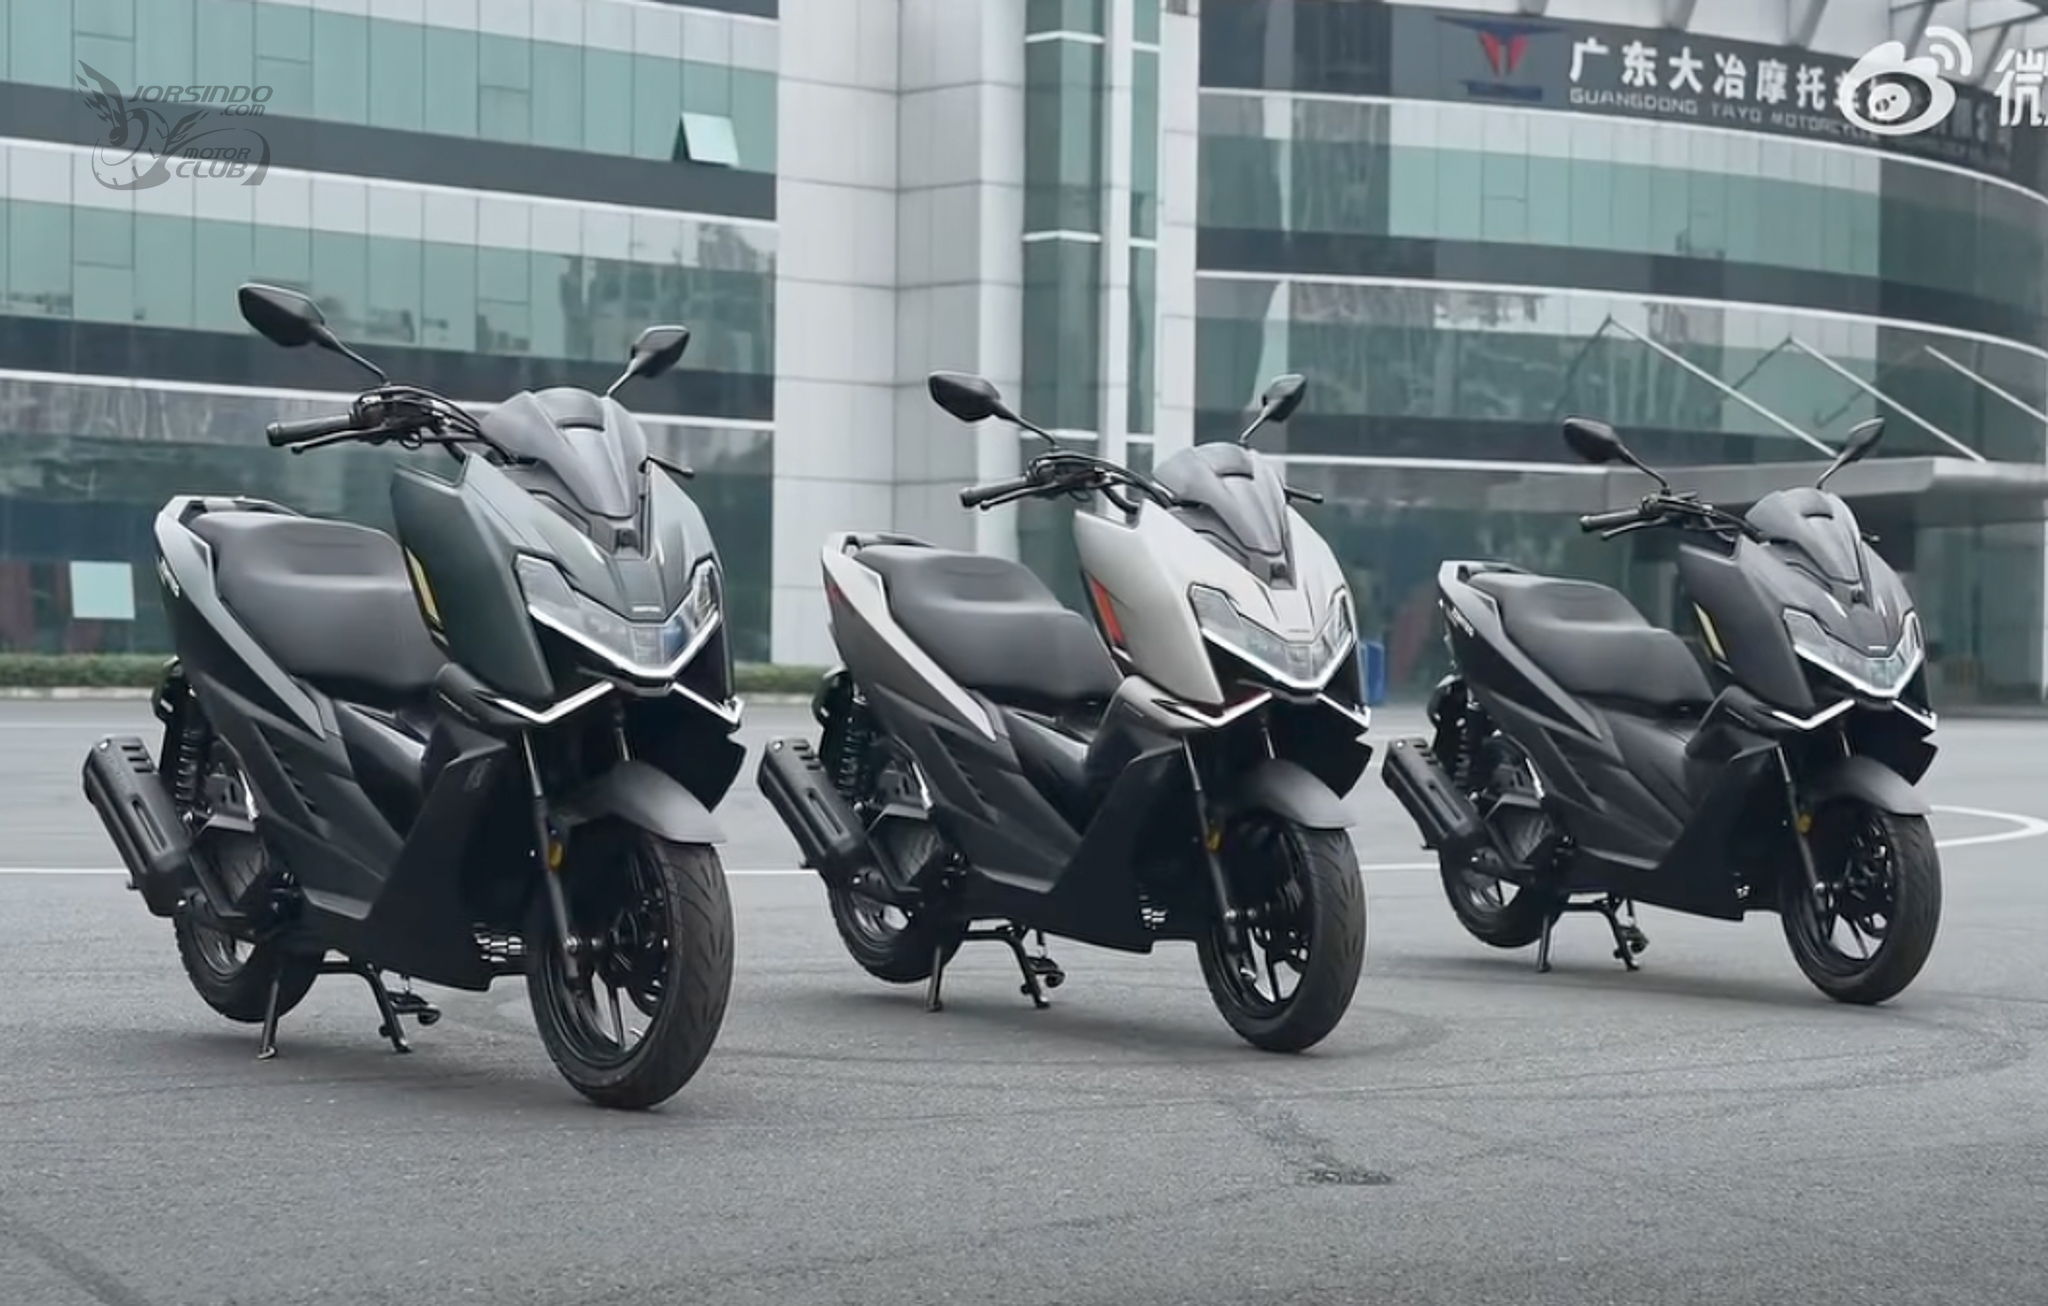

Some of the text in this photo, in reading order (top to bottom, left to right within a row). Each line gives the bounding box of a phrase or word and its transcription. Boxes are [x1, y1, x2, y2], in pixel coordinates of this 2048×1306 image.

[1569, 36, 1859, 112] 广东大冶摩托
[1569, 86, 1699, 116] GUANGDONG
[1710, 102, 1762, 124] TAYO
